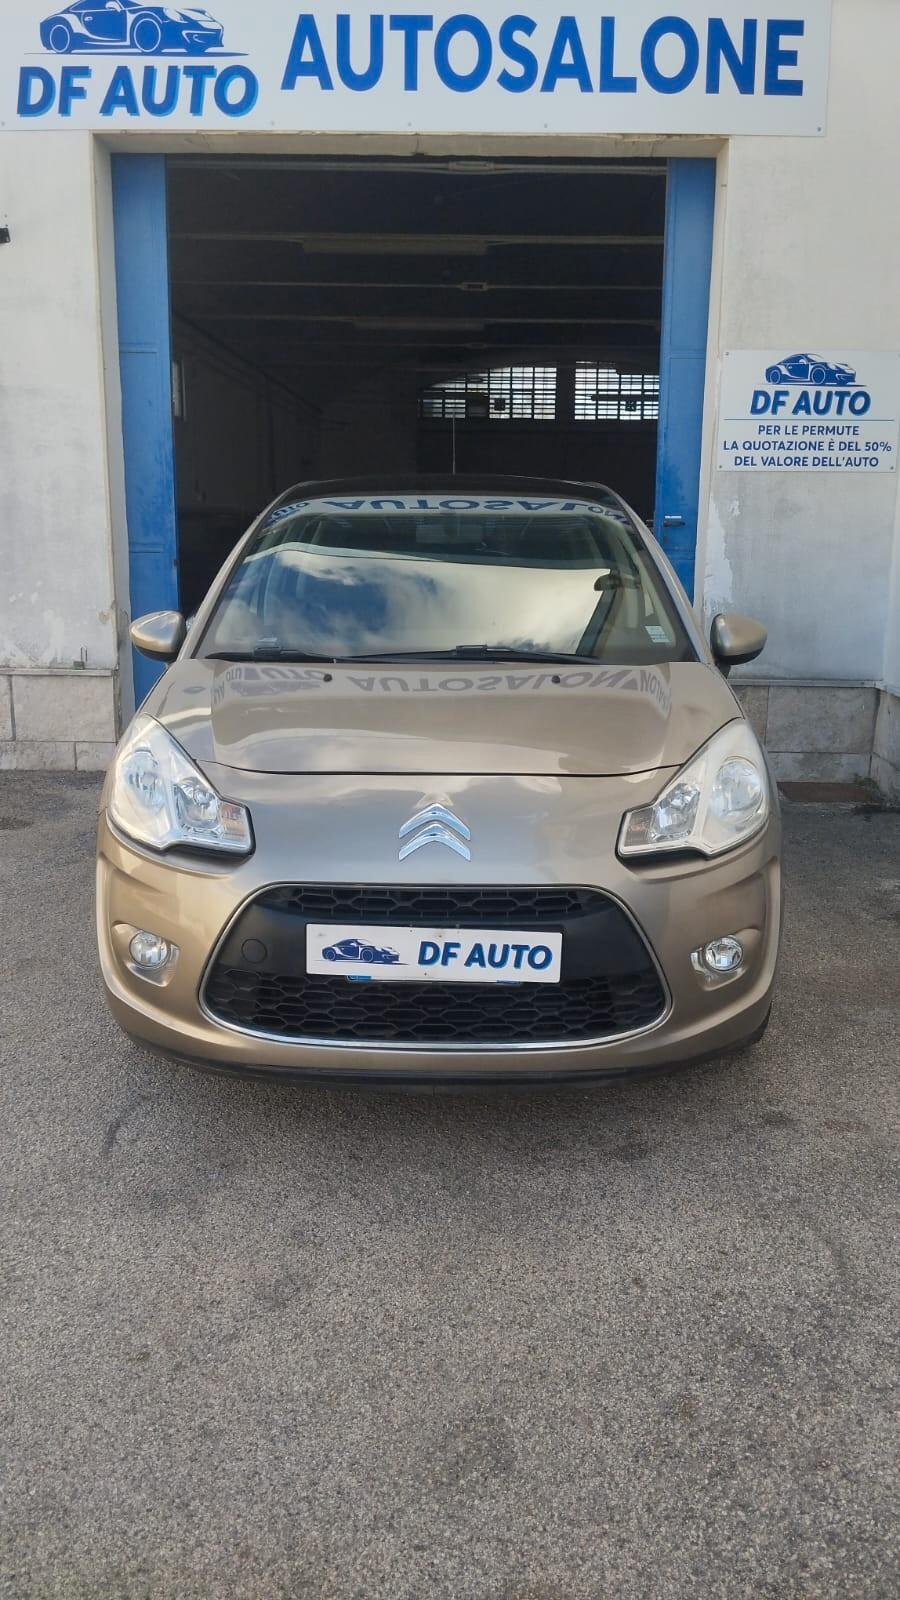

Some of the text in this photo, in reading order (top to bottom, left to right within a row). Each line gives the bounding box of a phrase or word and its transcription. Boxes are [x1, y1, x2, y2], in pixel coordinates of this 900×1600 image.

[280, 13, 805, 97] AUTOSALONE
[17, 64, 259, 117] DF AUTO
[750, 390, 871, 417] DF AUTO
[758, 425, 860, 436] PER LE PERMUTE
[723, 438, 892, 452] LA QUOTAZIONE È DEL 50%
[734, 456, 879, 468] DEL VALORE DELL'AUTO
[417, 940, 553, 970] DF AUTO
